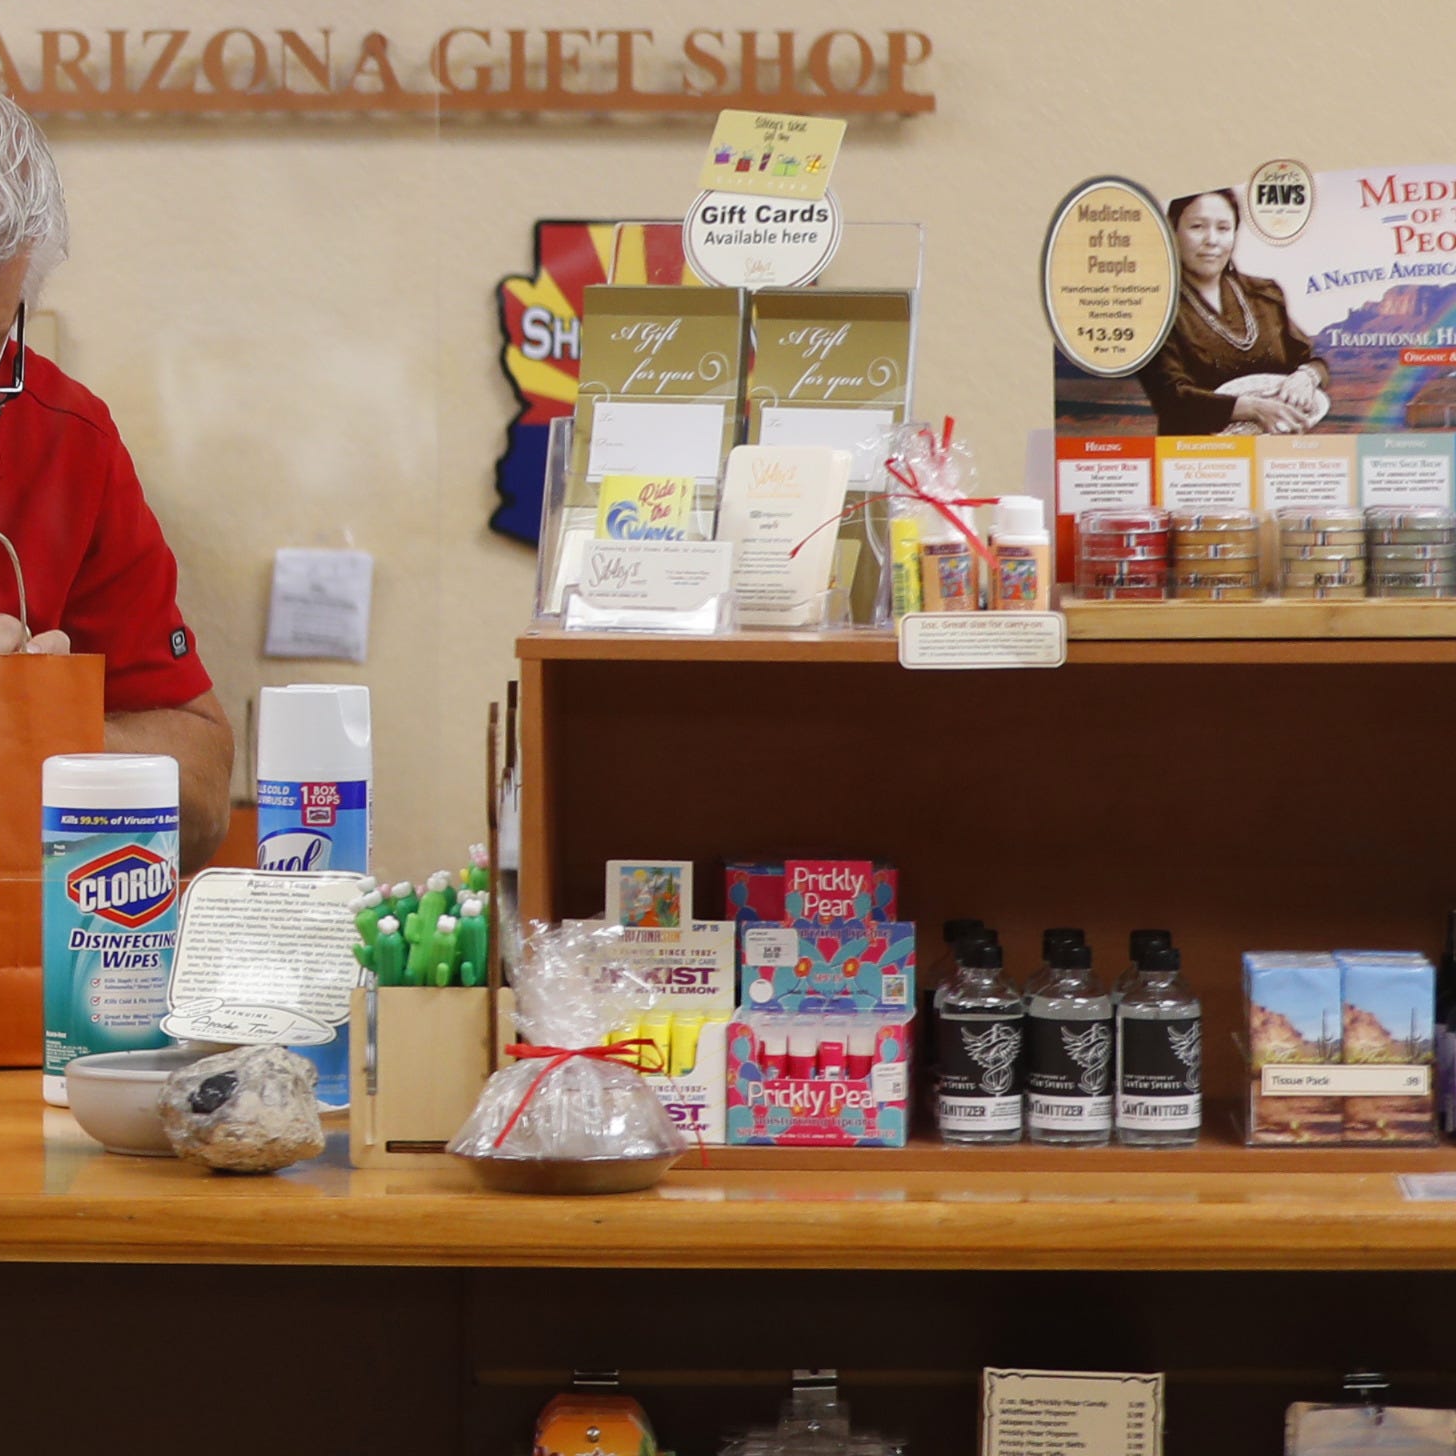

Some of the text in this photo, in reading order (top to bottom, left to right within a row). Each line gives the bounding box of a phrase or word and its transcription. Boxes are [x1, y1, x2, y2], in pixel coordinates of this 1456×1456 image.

[431, 27, 653, 95] GIFT
[681, 27, 933, 96] SHOP
[1256, 184, 1305, 206] FAVS
[701, 204, 829, 224] Gift Cards
[1078, 204, 1142, 222] Medicine
[1410, 208, 1443, 224] OF
[704, 230, 818, 245] Available here
[1089, 230, 1131, 247] of the
[1391, 224, 1456, 255] PEO
[1088, 255, 1136, 276] People
[1306, 260, 1456, 294] A NATIVE AMERICA
[521, 306, 580, 360] SH
[633, 317, 683, 355] Gift
[802, 323, 852, 360] Gift
[1078, 327, 1134, 341] $13.99
[1325, 328, 1433, 347] TRADITIONAL
[621, 357, 696, 394] for you
[789, 362, 864, 400] for you
[639, 480, 676, 506] Ride
[310, 796, 341, 805] TOPS
[313, 786, 337, 795] BOX
[61, 815, 78, 825] Kills
[80, 816, 108, 825] 99.9%
[110, 816, 123, 825] of
[79, 860, 174, 913] CLOROX
[793, 867, 864, 898] Prickly
[804, 892, 854, 916] Pear
[71, 930, 176, 948] DISINFECTING
[103, 951, 159, 968] WIPES
[670, 986, 716, 994] LEMON
[748, 1081, 825, 1116] Prickly
